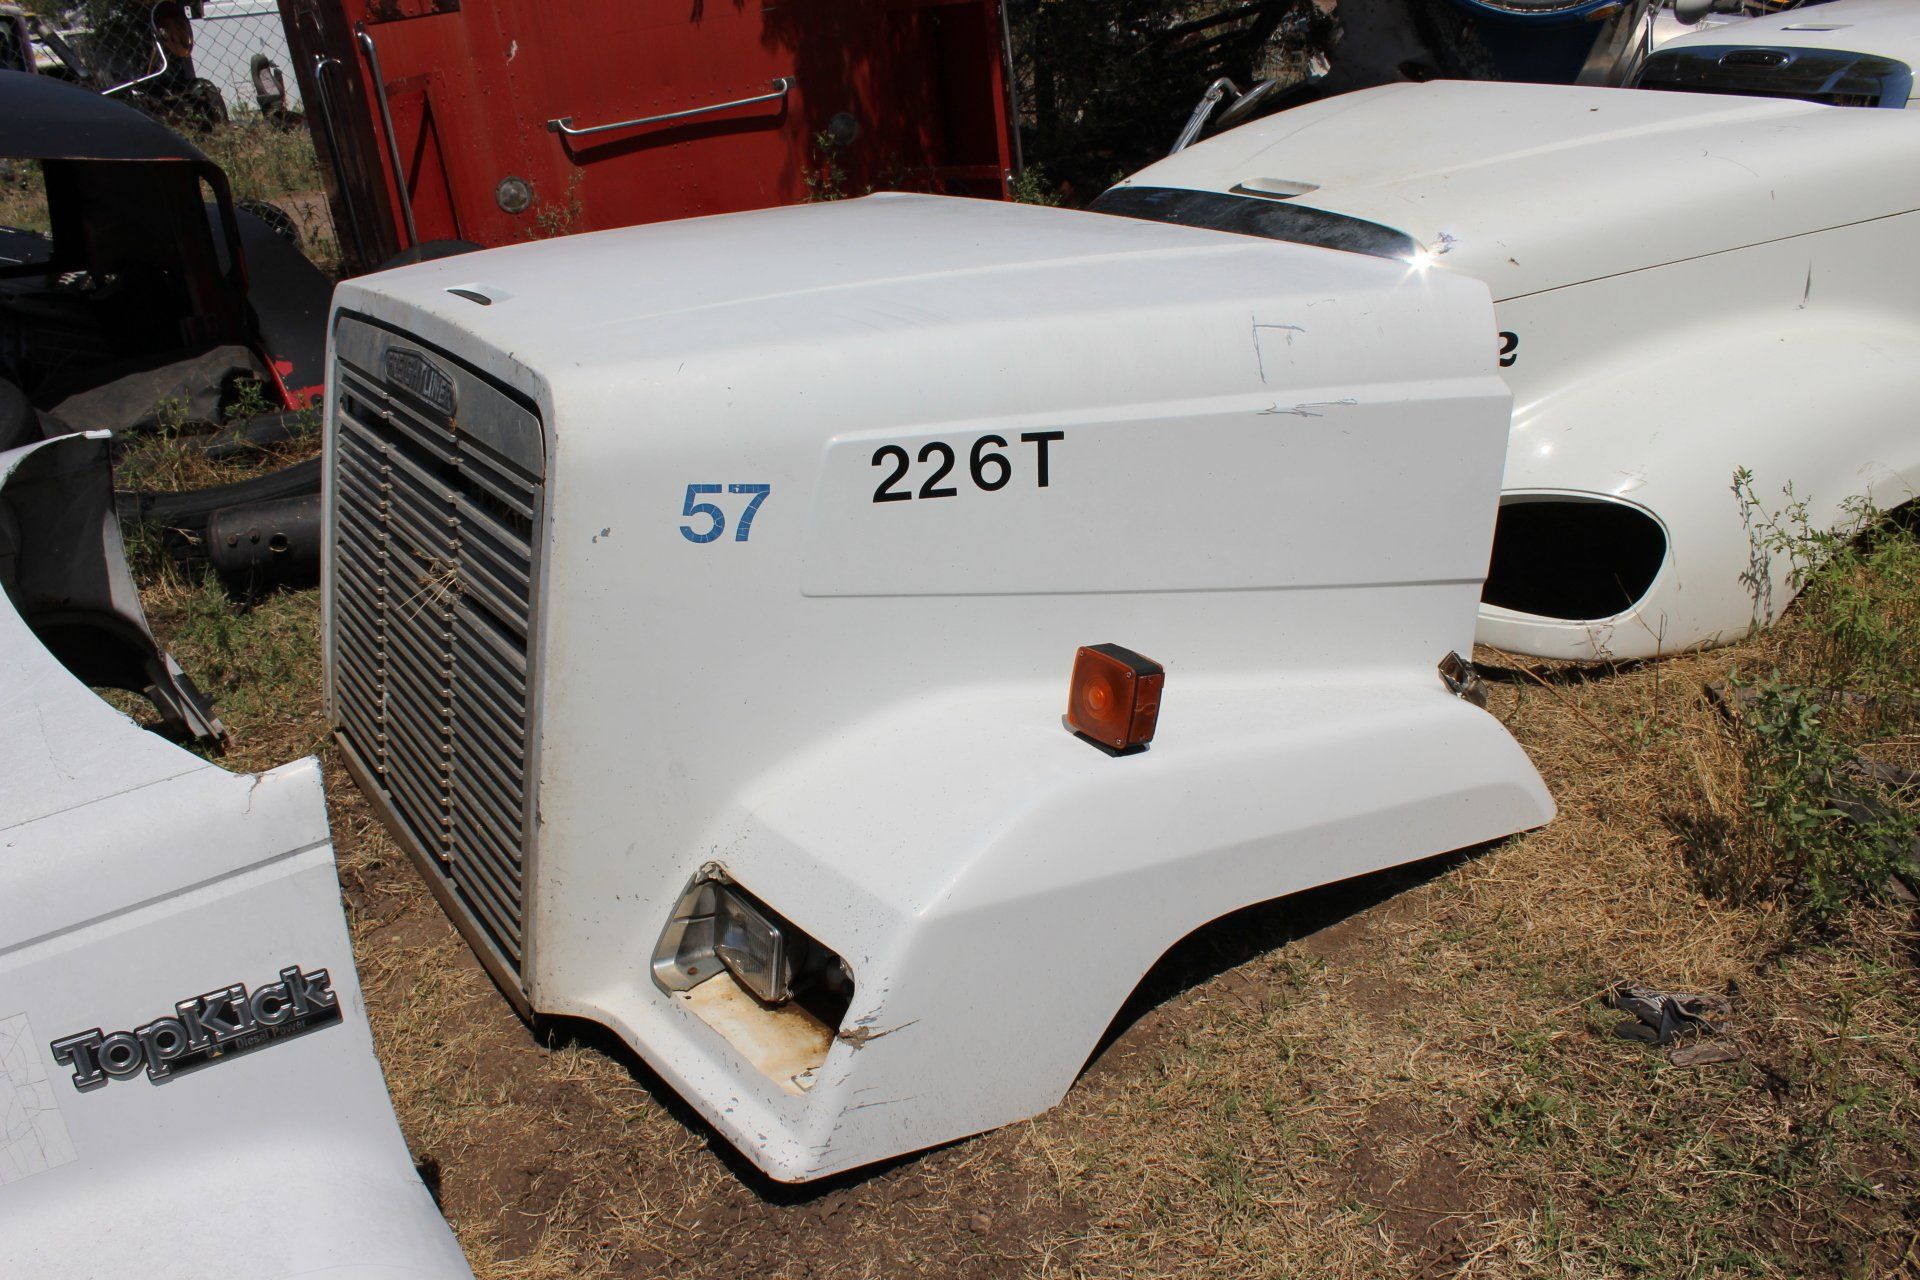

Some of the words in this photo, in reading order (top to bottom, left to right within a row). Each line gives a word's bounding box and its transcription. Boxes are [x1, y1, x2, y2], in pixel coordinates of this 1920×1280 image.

[871, 430, 1064, 503] 226T
[679, 483, 771, 544] 57
[50, 966, 338, 1090] TopKick
[234, 1028, 269, 1049] Diesel
[271, 1019, 306, 1038] Power
